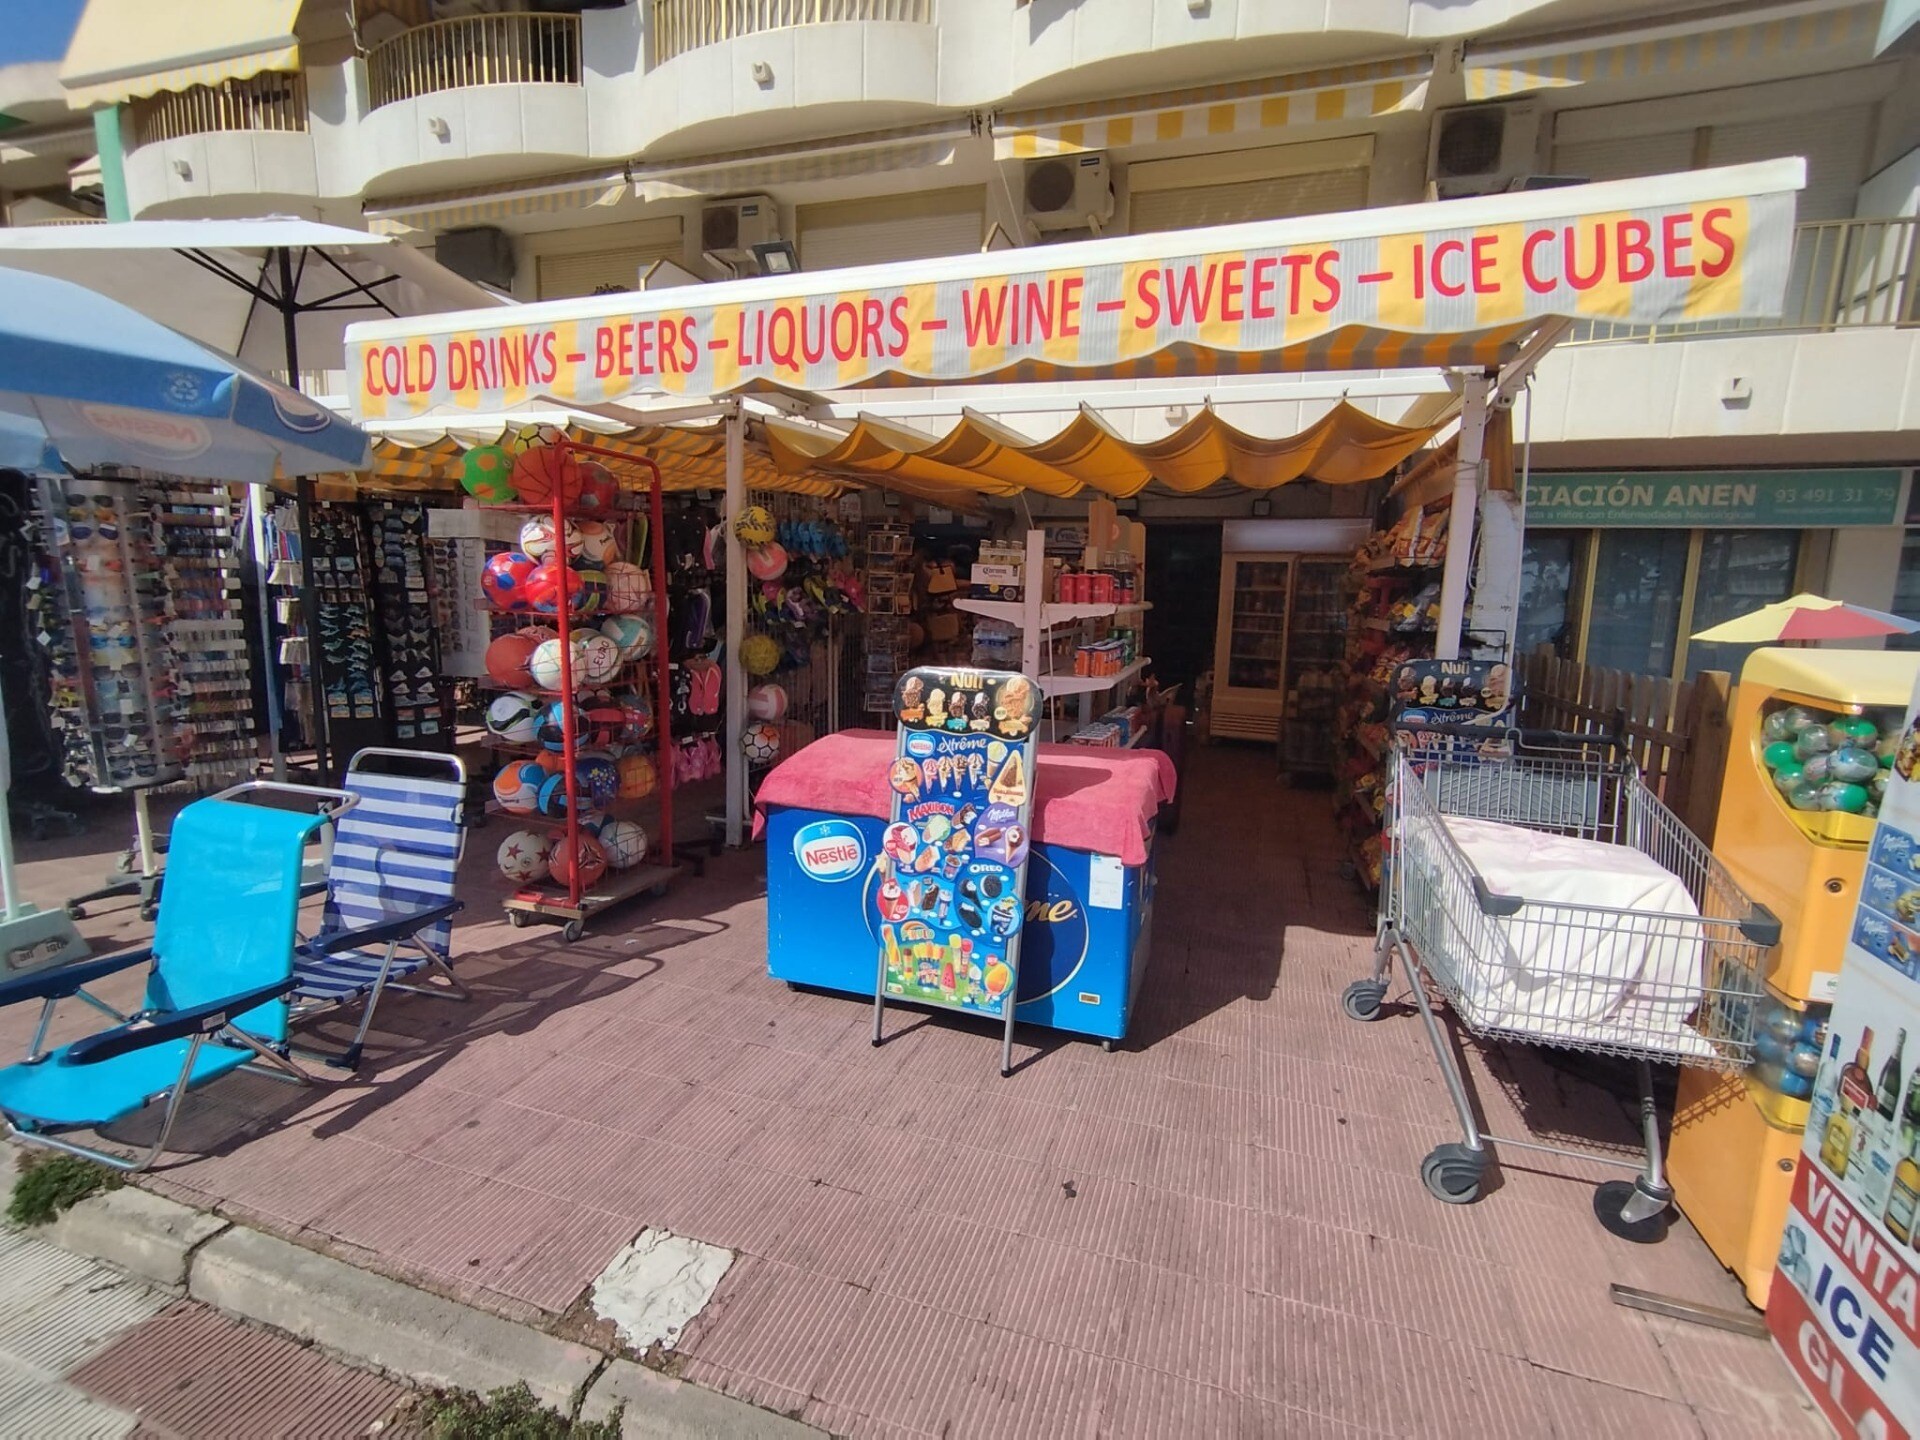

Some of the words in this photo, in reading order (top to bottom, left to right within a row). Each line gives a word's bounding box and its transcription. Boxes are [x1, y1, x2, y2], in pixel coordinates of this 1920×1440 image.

[365, 343, 437, 396] COLD
[447, 331, 557, 391] DRINKS
[595, 315, 698, 379] BEERS
[737, 296, 909, 367] LIQUORS
[962, 278, 1083, 347] WINE
[1135, 250, 1340, 329] SWEETS
[1413, 234, 1500, 299] ICE
[1521, 207, 1735, 294] CUBES
[1662, 483, 1757, 507] ANEN
[1801, 487, 1833, 503] 491
[1844, 487, 1862, 502] 31
[907, 801, 955, 821] MAXIBON
[987, 807, 1016, 821] Milka
[805, 844, 858, 867] Nestlé
[969, 863, 1003, 873] OREO
[1807, 1167, 1918, 1332] VENTA
[1814, 1262, 1895, 1382] ICE
